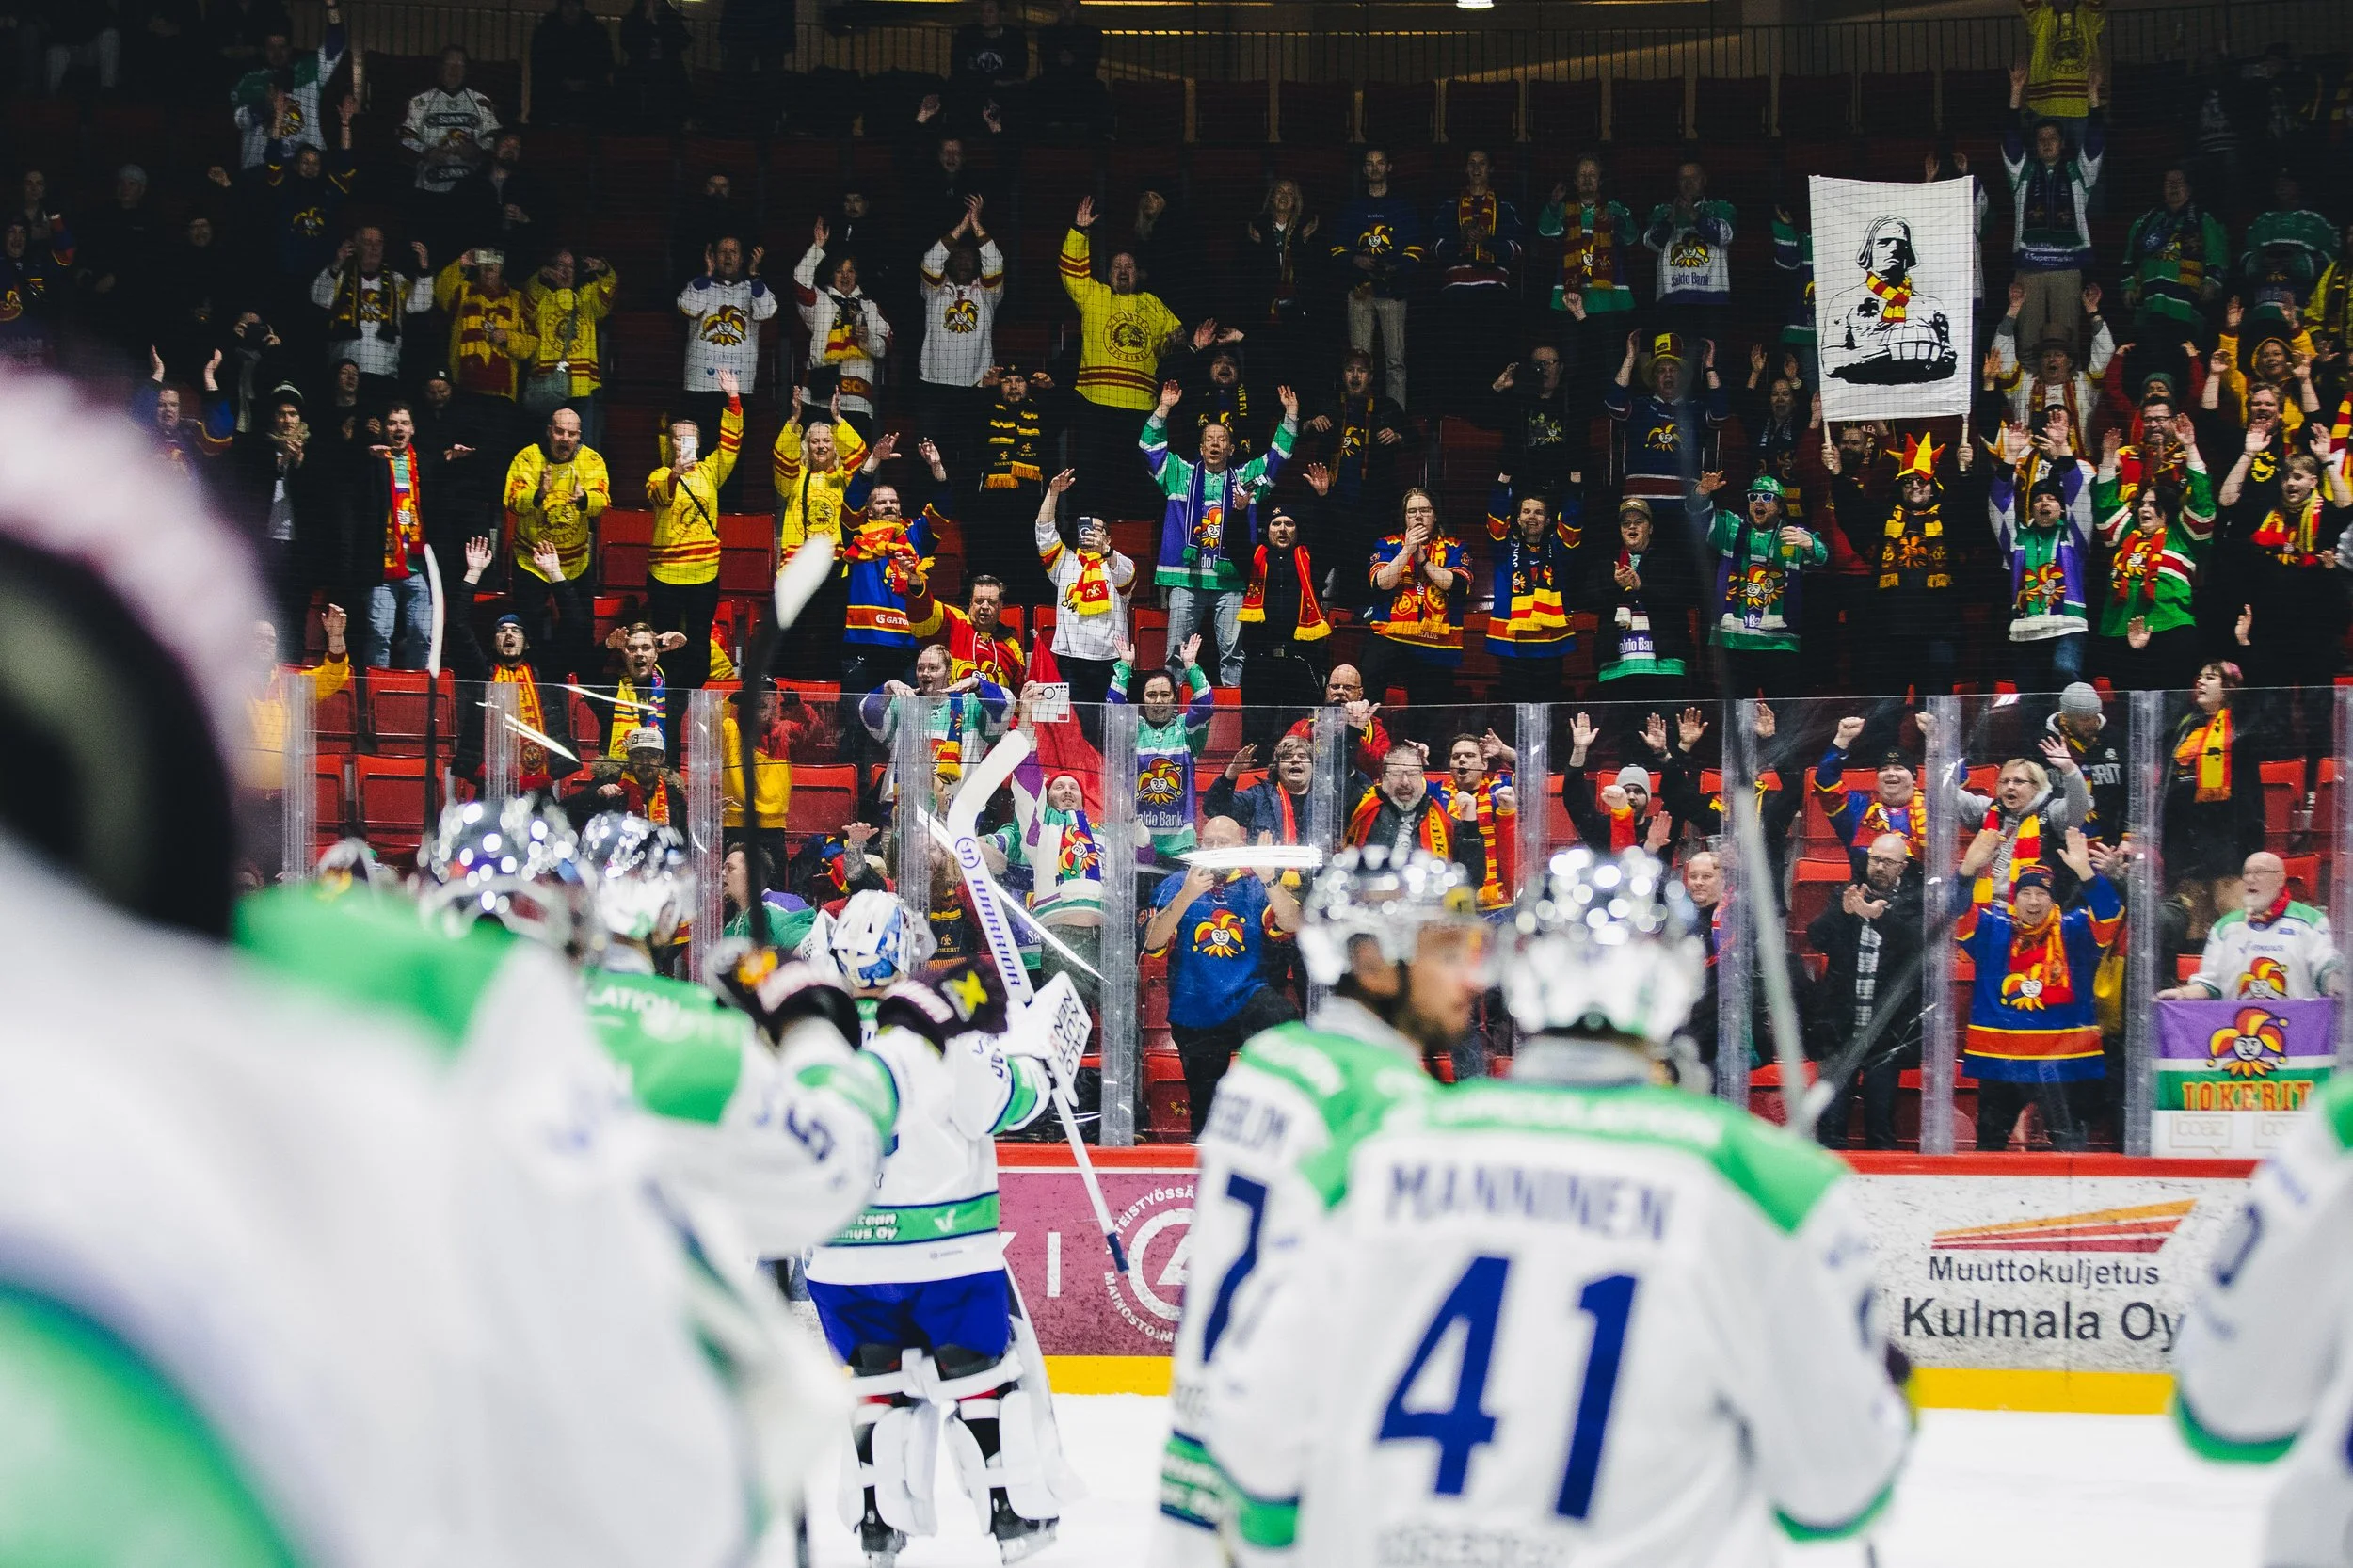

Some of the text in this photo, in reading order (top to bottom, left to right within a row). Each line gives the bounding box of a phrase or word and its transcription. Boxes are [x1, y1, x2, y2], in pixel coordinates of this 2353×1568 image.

[1159, 811, 1184, 827] Bank
[972, 879, 1022, 986] WARRIOR
[1929, 1256, 2160, 1289] Muuttokuljetus
[1902, 1296, 2185, 1352] Kulmala Oy
[1376, 1255, 1636, 1520] 41
